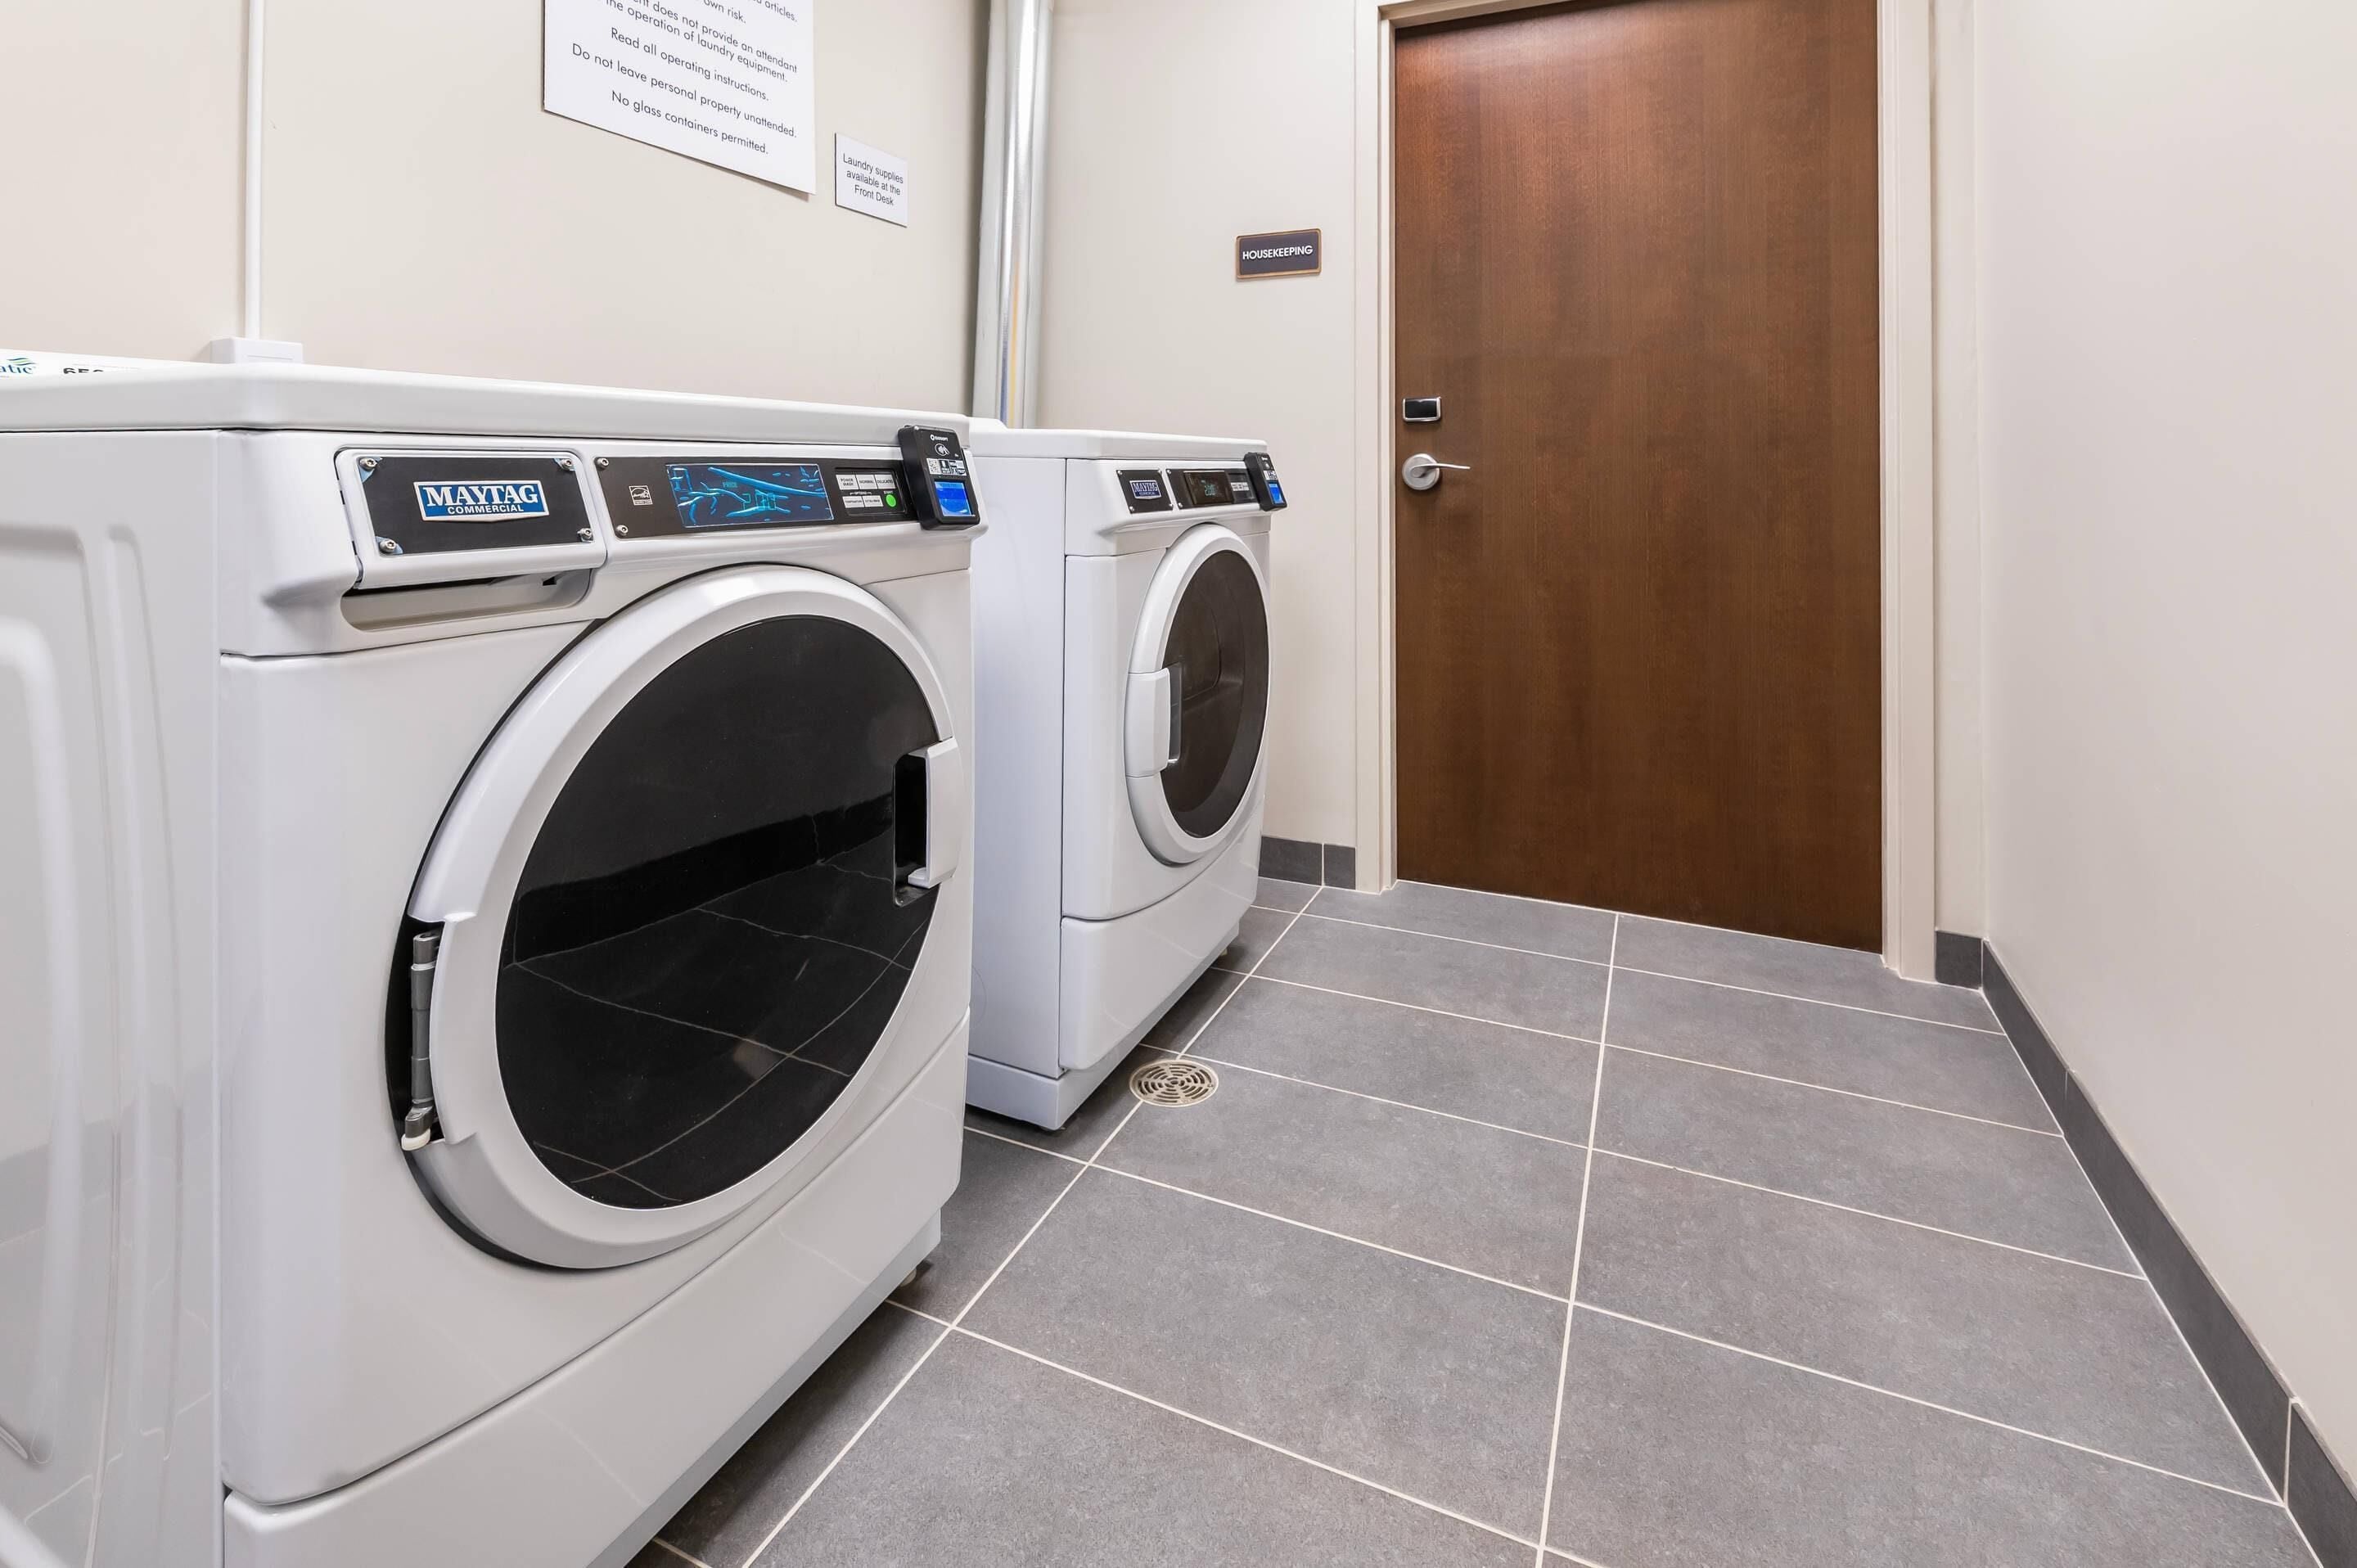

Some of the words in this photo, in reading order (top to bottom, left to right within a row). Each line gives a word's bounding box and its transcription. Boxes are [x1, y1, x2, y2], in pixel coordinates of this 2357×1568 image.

[704, 0, 724, 13] own
[727, 7, 746, 24] risk.
[764, 1, 798, 22] articles.
[628, 7, 680, 36] operation
[683, 31, 695, 42] of
[697, 34, 735, 61] laundry
[737, 55, 787, 82] equipment.
[653, 2, 678, 20] does
[683, 16, 698, 29] not
[702, 25, 738, 47] provide
[741, 43, 753, 53] an
[756, 49, 797, 73] attendant
[611, 27, 639, 49] Read
[643, 43, 656, 56] all
[660, 52, 710, 79] operating
[714, 70, 769, 101] instructions.
[572, 43, 590, 60] Do
[594, 56, 613, 70] not
[618, 60, 647, 83] leave
[651, 78, 696, 101] personal
[701, 96, 741, 119] property
[744, 112, 797, 138] unattended.
[612, 90, 629, 106] No
[633, 100, 661, 118] glass
[665, 112, 719, 137] containers
[721, 132, 768, 155] permitted.
[842, 152, 874, 174] Laundry
[875, 166, 904, 184] supplies
[846, 169, 880, 187] available
[881, 182, 889, 191] at
[890, 183, 901, 196] the
[854, 184, 874, 200] Front
[876, 191, 895, 206] Desk
[1242, 245, 1314, 260] HOUSEKEEPING
[422, 484, 539, 507] MAYTAG
[1132, 482, 1158, 493] MAYTAG
[447, 504, 525, 515] COMMERCIAL
